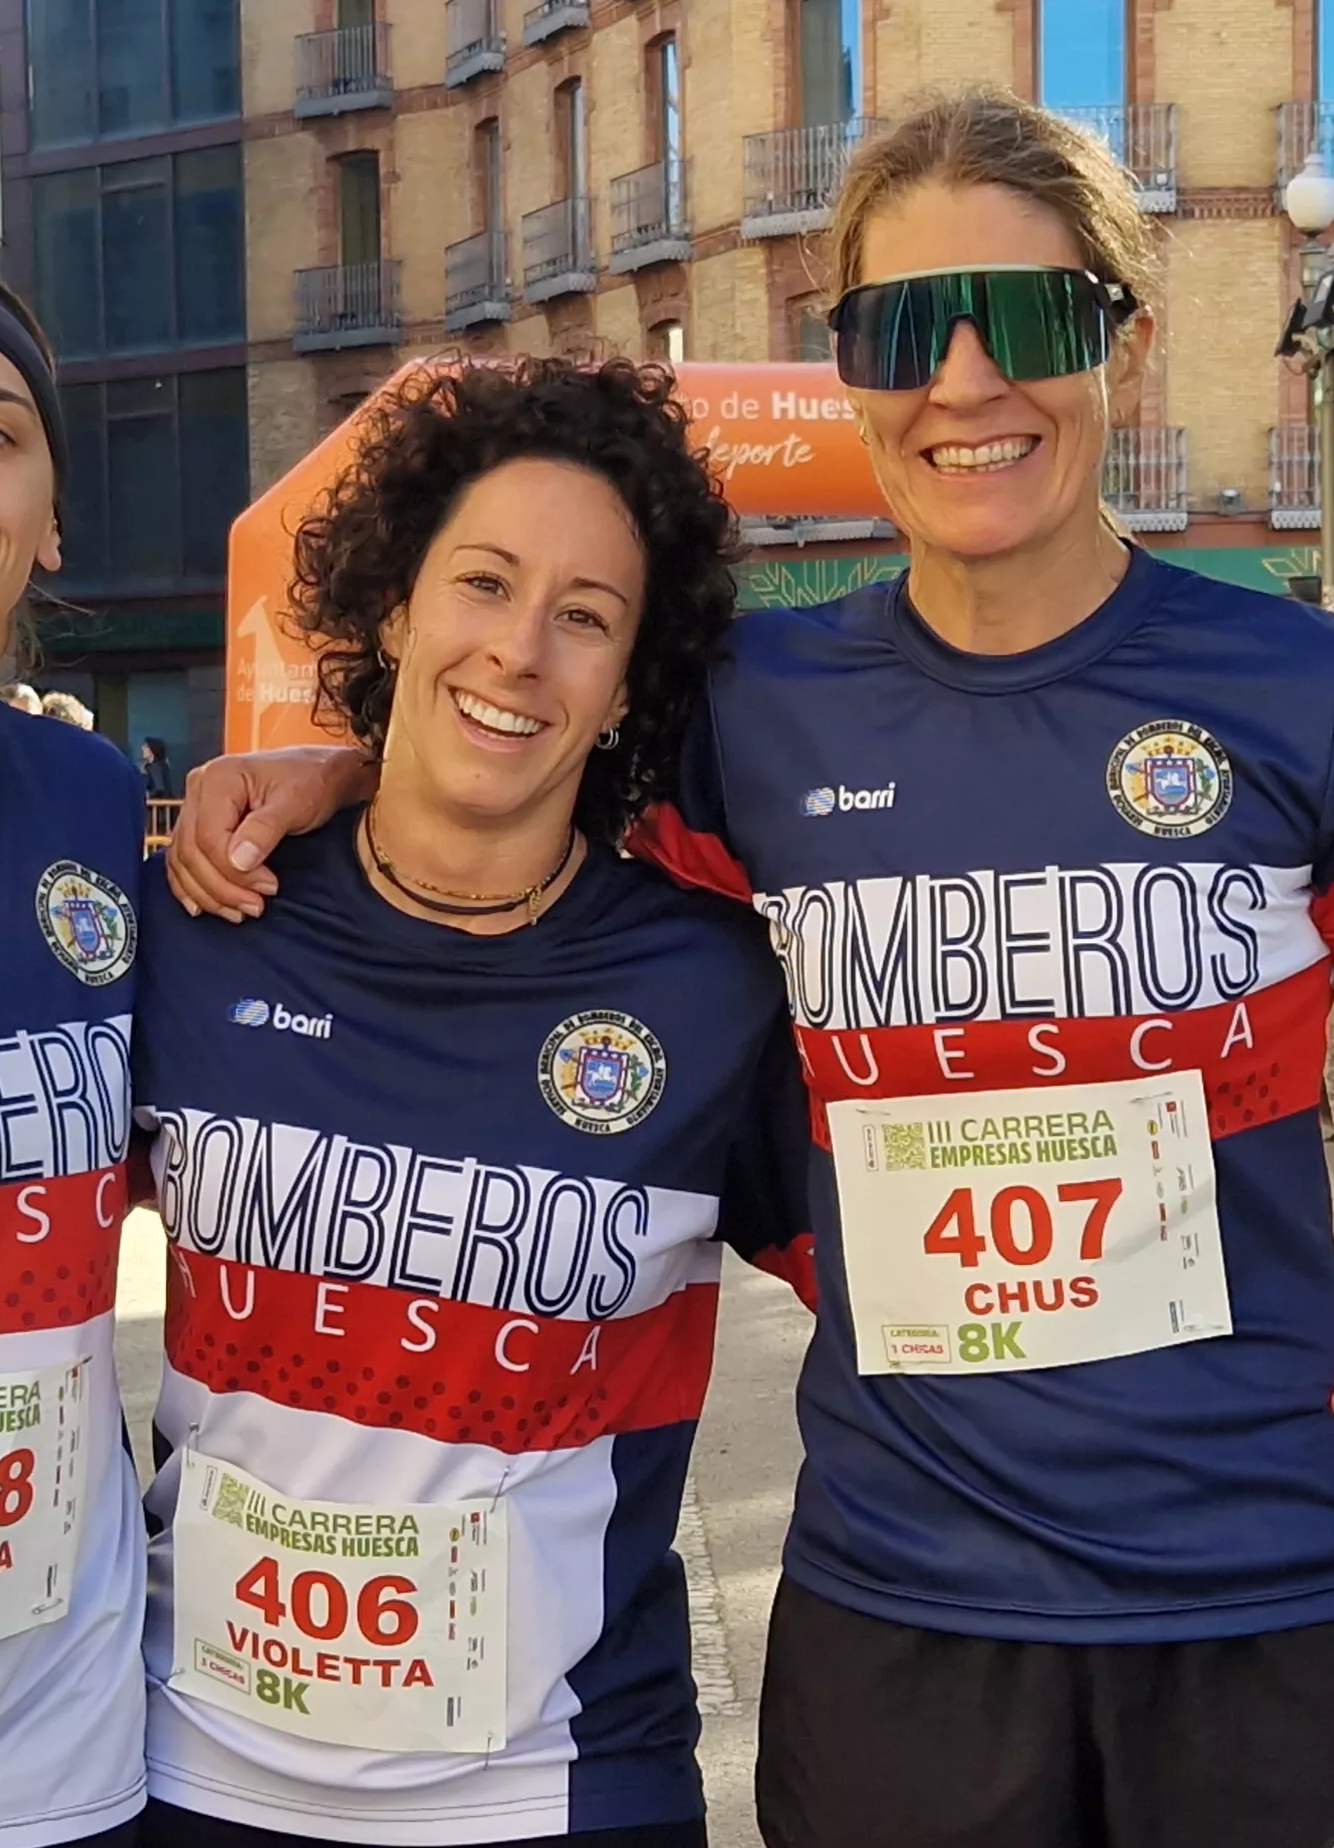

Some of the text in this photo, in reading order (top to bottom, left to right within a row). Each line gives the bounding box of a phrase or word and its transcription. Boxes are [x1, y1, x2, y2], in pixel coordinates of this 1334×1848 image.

[721, 391, 759, 420] de
[237, 682, 255, 703] de
[838, 782, 896, 812] barri
[273, 1002, 333, 1040] barri
[928, 1109, 1116, 1143] III CARRERA
[930, 1134, 1118, 1169] EMPRESAS HUESCA
[159, 1112, 649, 1321] BOMBEROS
[924, 1178, 1123, 1268] 407
[170, 1244, 603, 1375] HUESCA
[965, 1276, 1099, 1315] CHUS
[957, 1321, 1027, 1363] 8K
[246, 1489, 266, 1516] III
[271, 1503, 420, 1536] CARRERA
[246, 1512, 420, 1558] EMPRESAS HUESCA
[235, 1556, 420, 1647] 406
[226, 1620, 435, 1688] VIOLETTA
[256, 1669, 311, 1716] 8K
